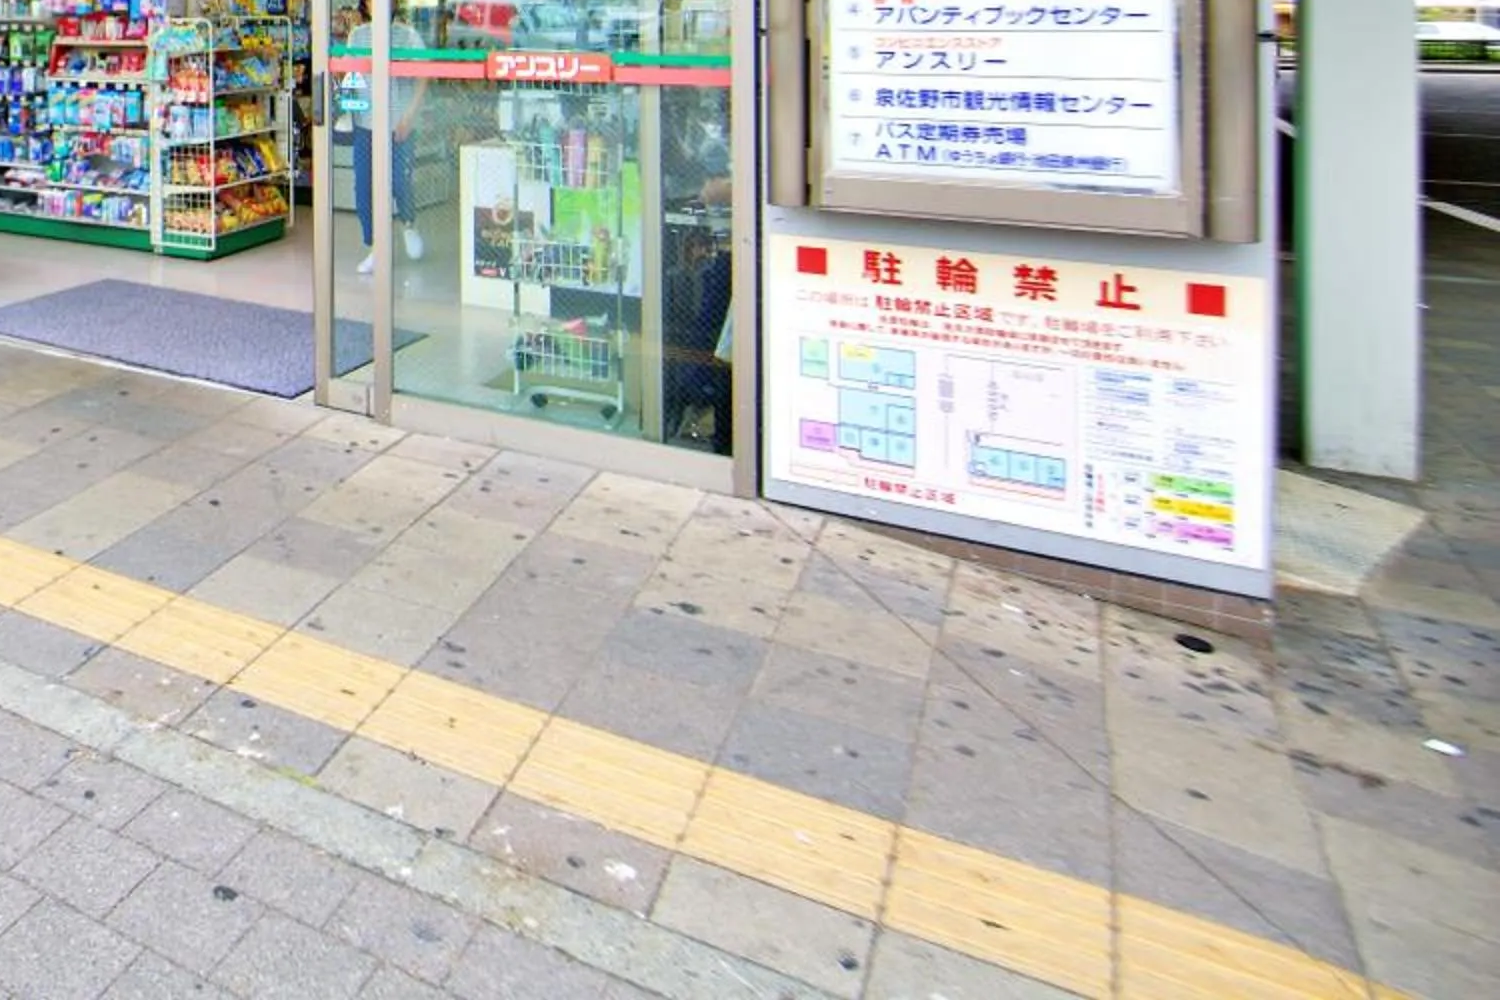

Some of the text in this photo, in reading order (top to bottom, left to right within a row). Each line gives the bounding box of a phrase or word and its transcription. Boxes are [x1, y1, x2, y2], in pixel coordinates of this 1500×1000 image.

[494, 54, 601, 78] アンスリー
[875, 51, 1007, 71] アンスリー
[875, 88, 1153, 115] 泉佐野市観光情報センター
[875, 143, 937, 161] ATM
[862, 249, 1142, 311] 駐輪禁止
[875, 295, 995, 323] 駐輪禁止区域
